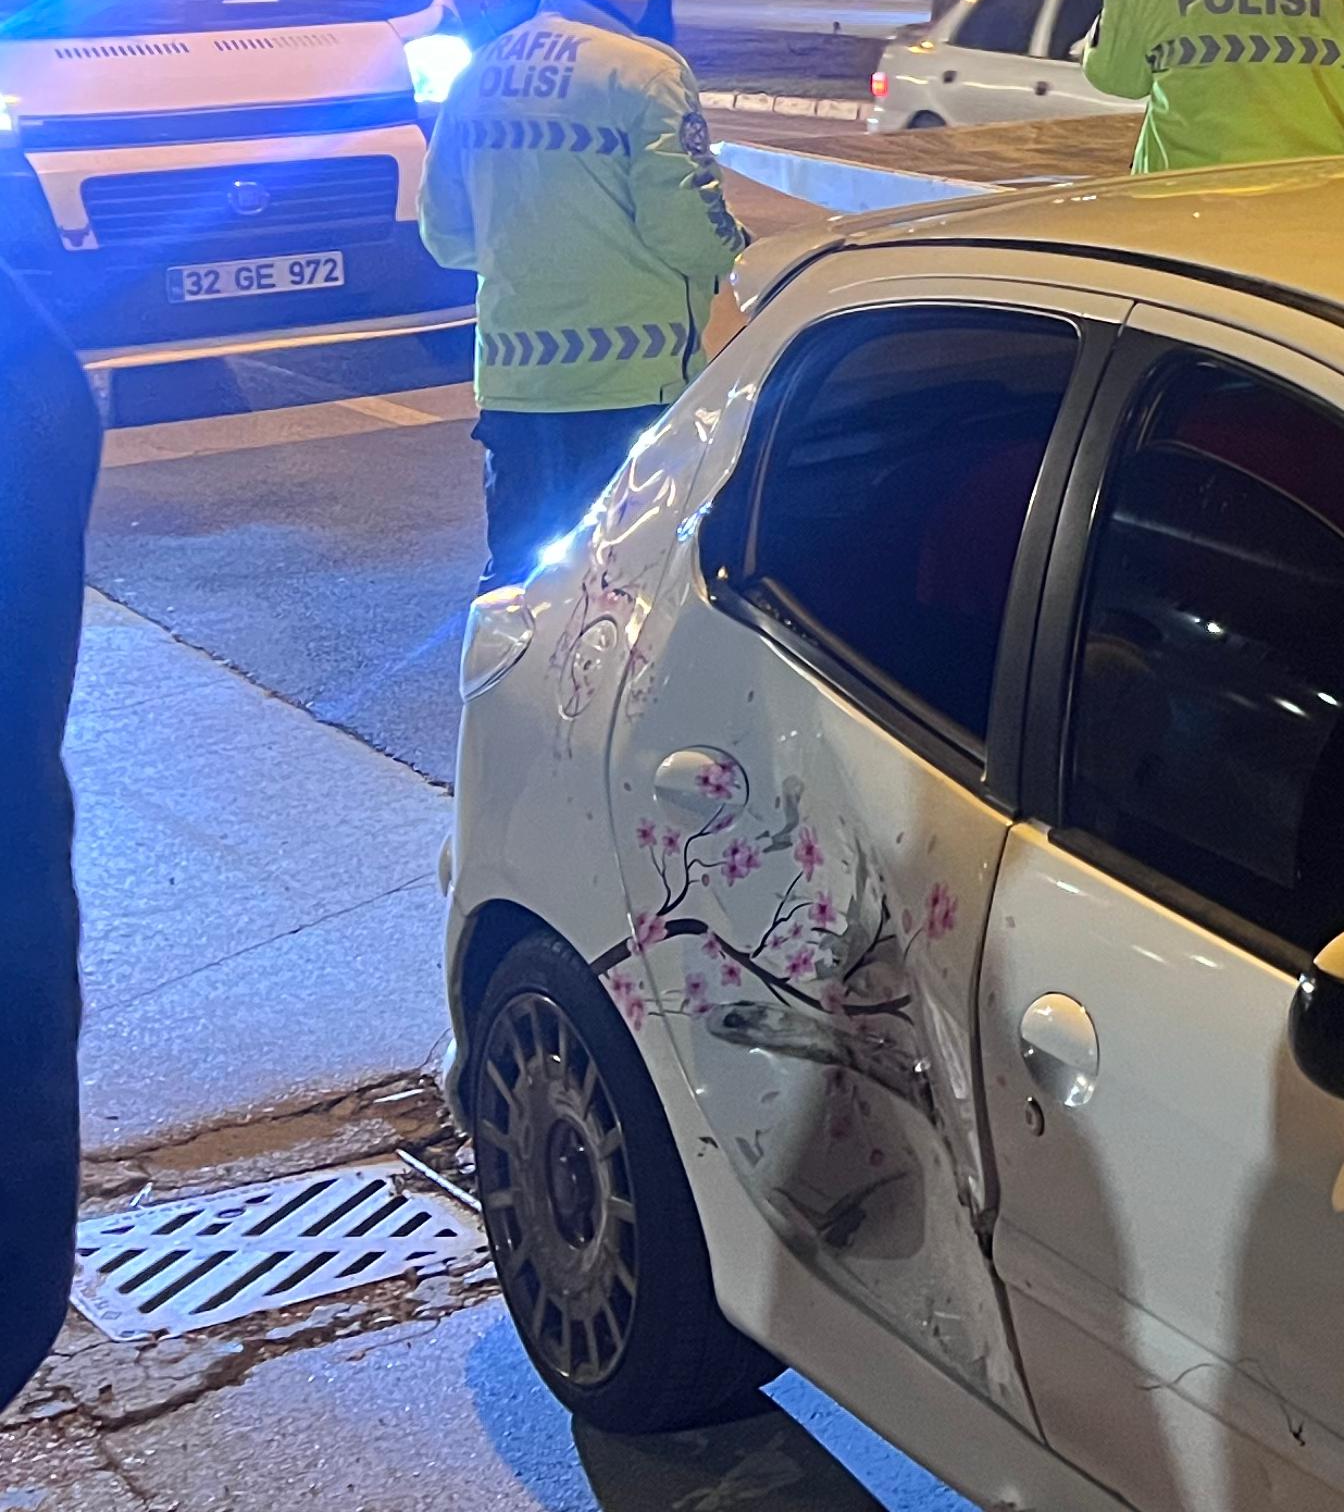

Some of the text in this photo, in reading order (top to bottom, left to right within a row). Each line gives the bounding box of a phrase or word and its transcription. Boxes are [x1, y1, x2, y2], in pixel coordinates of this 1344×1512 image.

[185, 257, 340, 296] 32 GE 972
